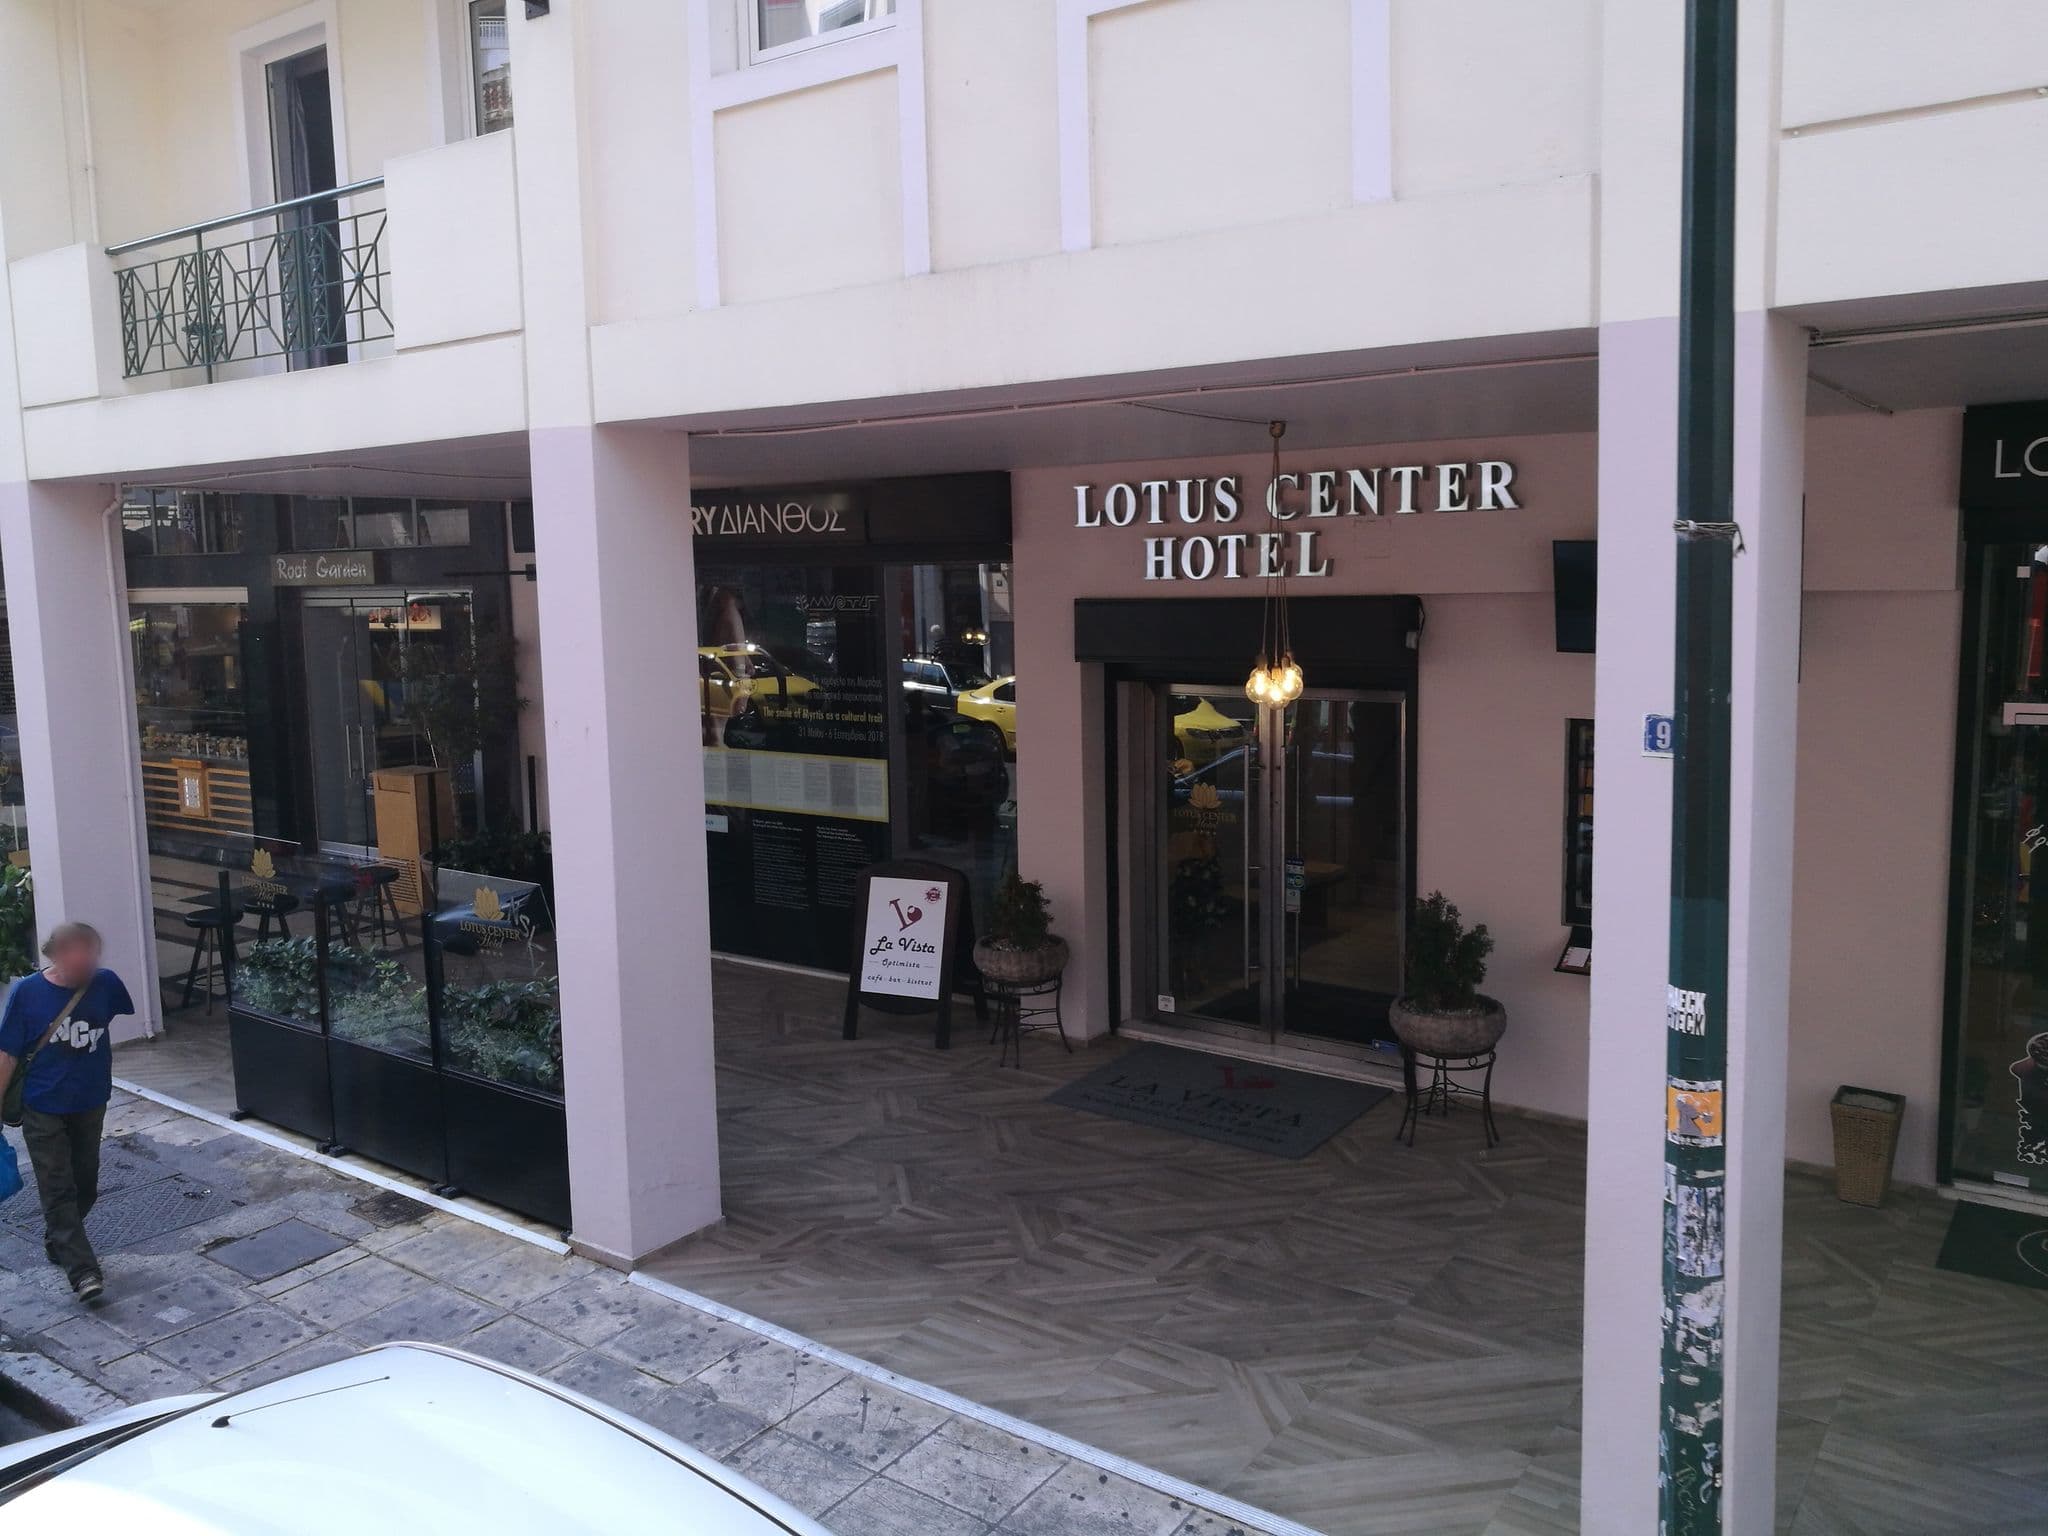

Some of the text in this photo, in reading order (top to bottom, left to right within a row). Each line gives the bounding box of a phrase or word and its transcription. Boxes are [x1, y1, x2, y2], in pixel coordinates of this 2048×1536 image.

[1074, 461, 1519, 527] LOTUS CENTER
[1144, 532, 1328, 581] HOTEL
[277, 556, 367, 579] Roof Garden
[763, 706, 775, 717] The
[794, 707, 801, 718] of
[841, 710, 866, 722] cultural
[1656, 721, 1671, 749] 9
[460, 920, 521, 941] LOTUS CENTER
[869, 936, 936, 955] La Vista
[882, 958, 921, 969] Optimista
[907, 977, 933, 986] bistrot
